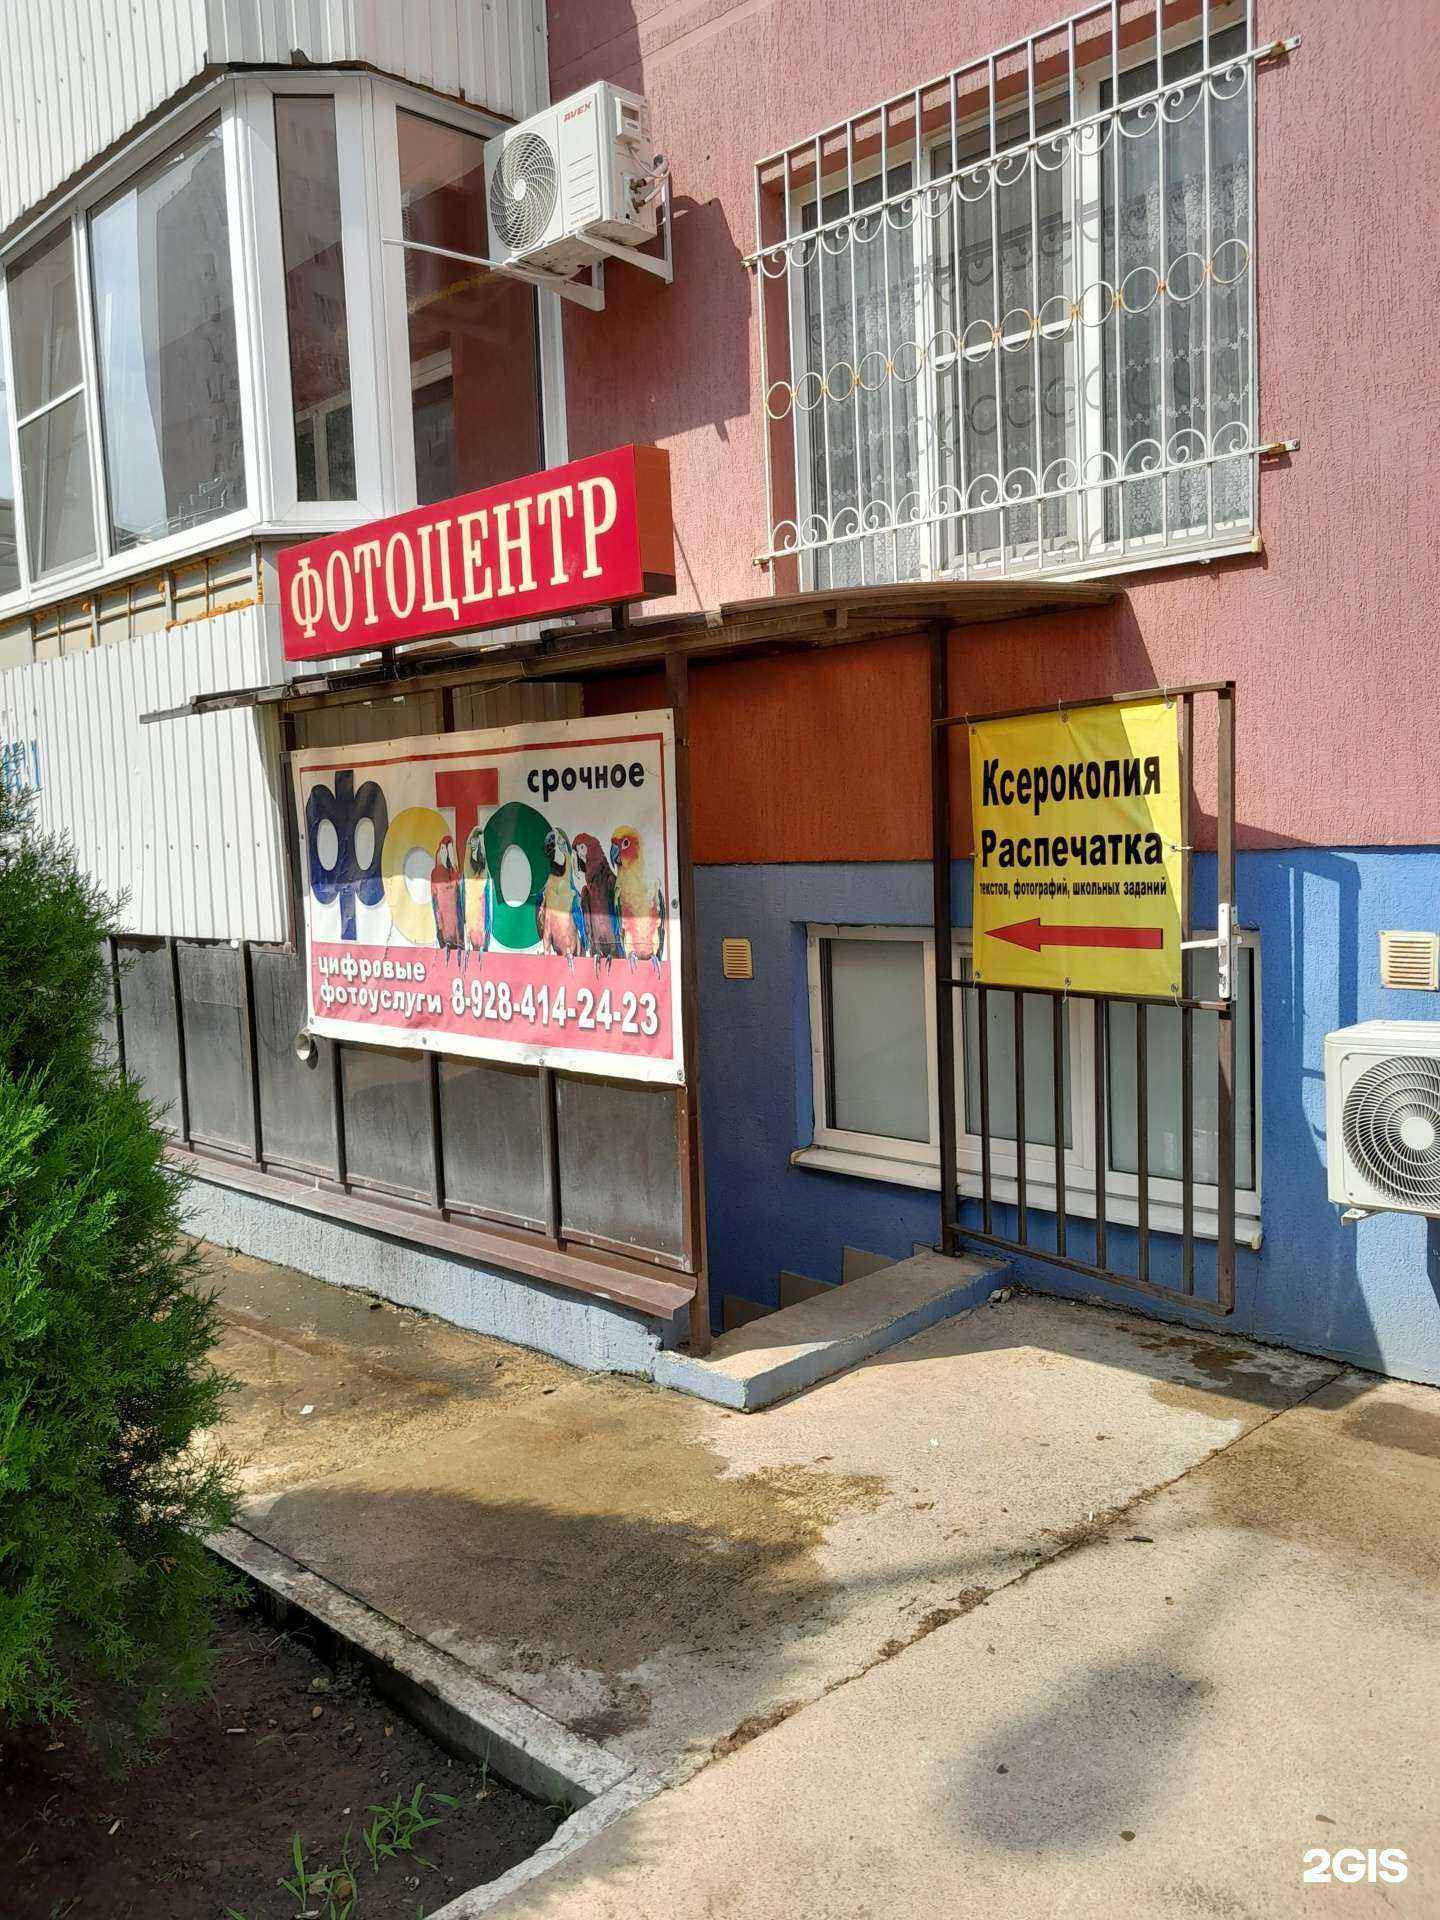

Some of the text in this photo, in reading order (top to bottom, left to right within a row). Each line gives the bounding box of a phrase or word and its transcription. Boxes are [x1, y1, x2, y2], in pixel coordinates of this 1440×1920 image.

[563, 100, 592, 122] AVEX
[290, 476, 618, 639] ФОТОЦЕНТР
[527, 762, 645, 802] срочное
[982, 755, 1161, 815] Ксерокопия
[981, 829, 1163, 868] Распечатка
[980, 876, 1167, 899] текстов, фотографий, школьных заданий
[318, 952, 427, 982] цифровые
[319, 978, 443, 1017] фотоуслуги
[451, 977, 660, 1037] 8-928-414-24-23
